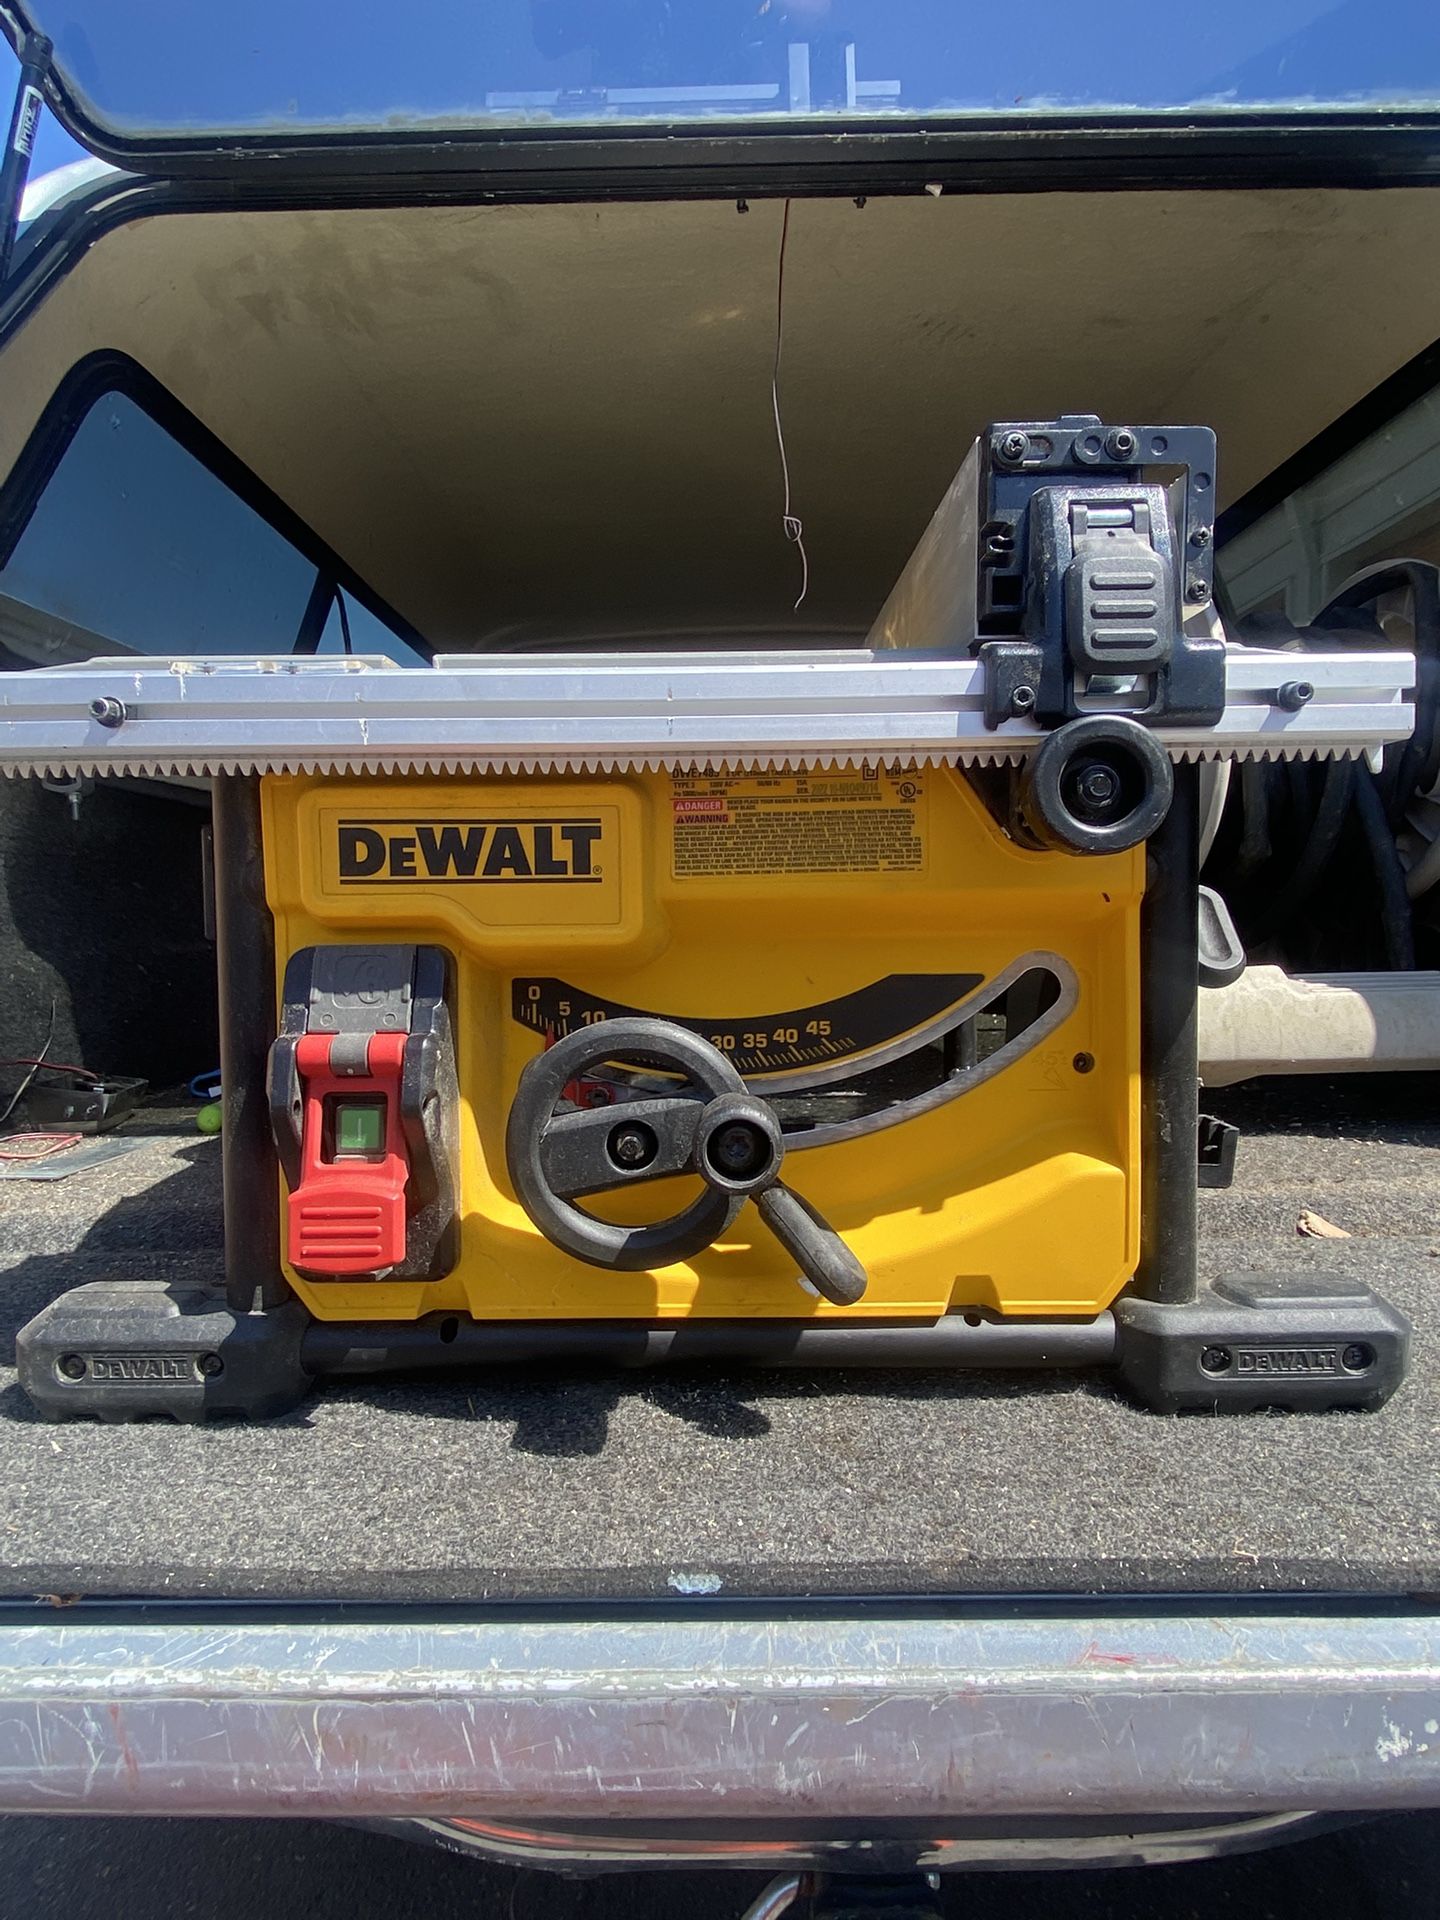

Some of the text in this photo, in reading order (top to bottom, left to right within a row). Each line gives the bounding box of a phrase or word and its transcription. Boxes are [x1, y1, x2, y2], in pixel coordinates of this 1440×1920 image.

[685, 801, 721, 810] DANGER
[686, 814, 728, 823] WARNING
[528, 985, 831, 1050] 0 5 10 30 35 40 45
